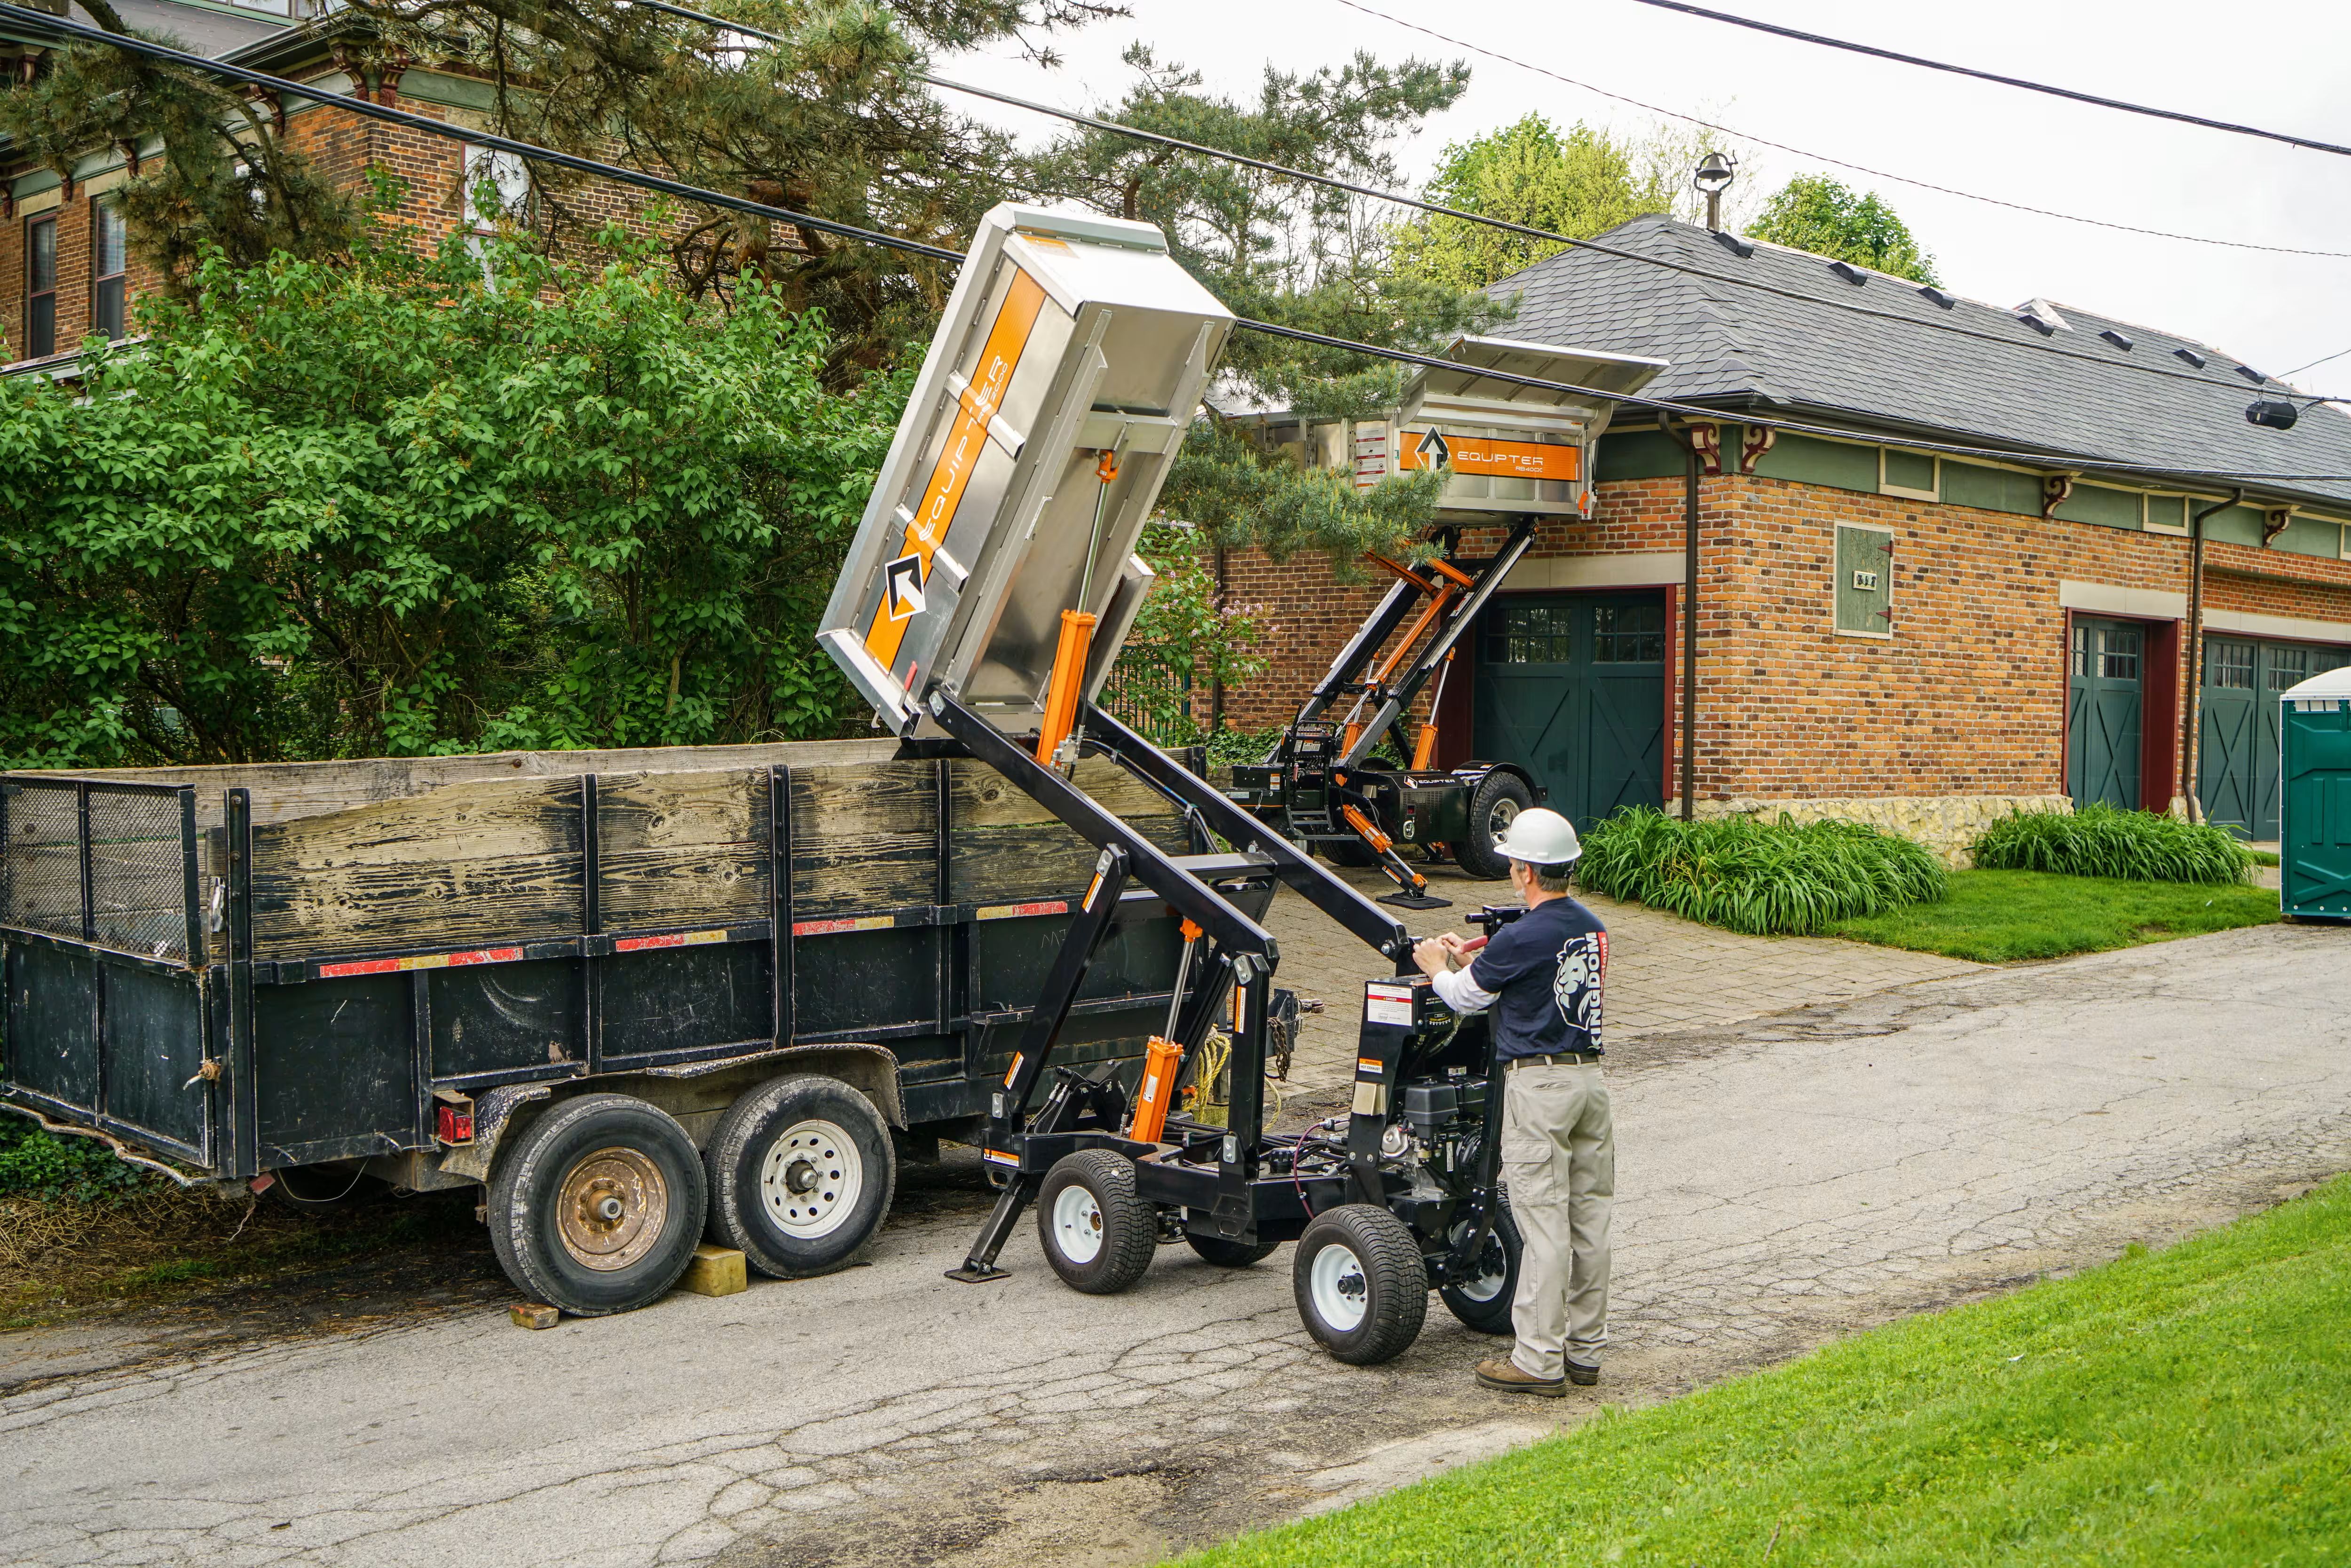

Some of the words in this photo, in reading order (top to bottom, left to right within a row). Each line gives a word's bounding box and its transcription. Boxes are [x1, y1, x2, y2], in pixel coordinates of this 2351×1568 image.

[918, 355, 1003, 542] EQUIPTER
[1457, 451, 1543, 465] EQUIPTER
[1586, 932, 1602, 1050] KINGDOM
